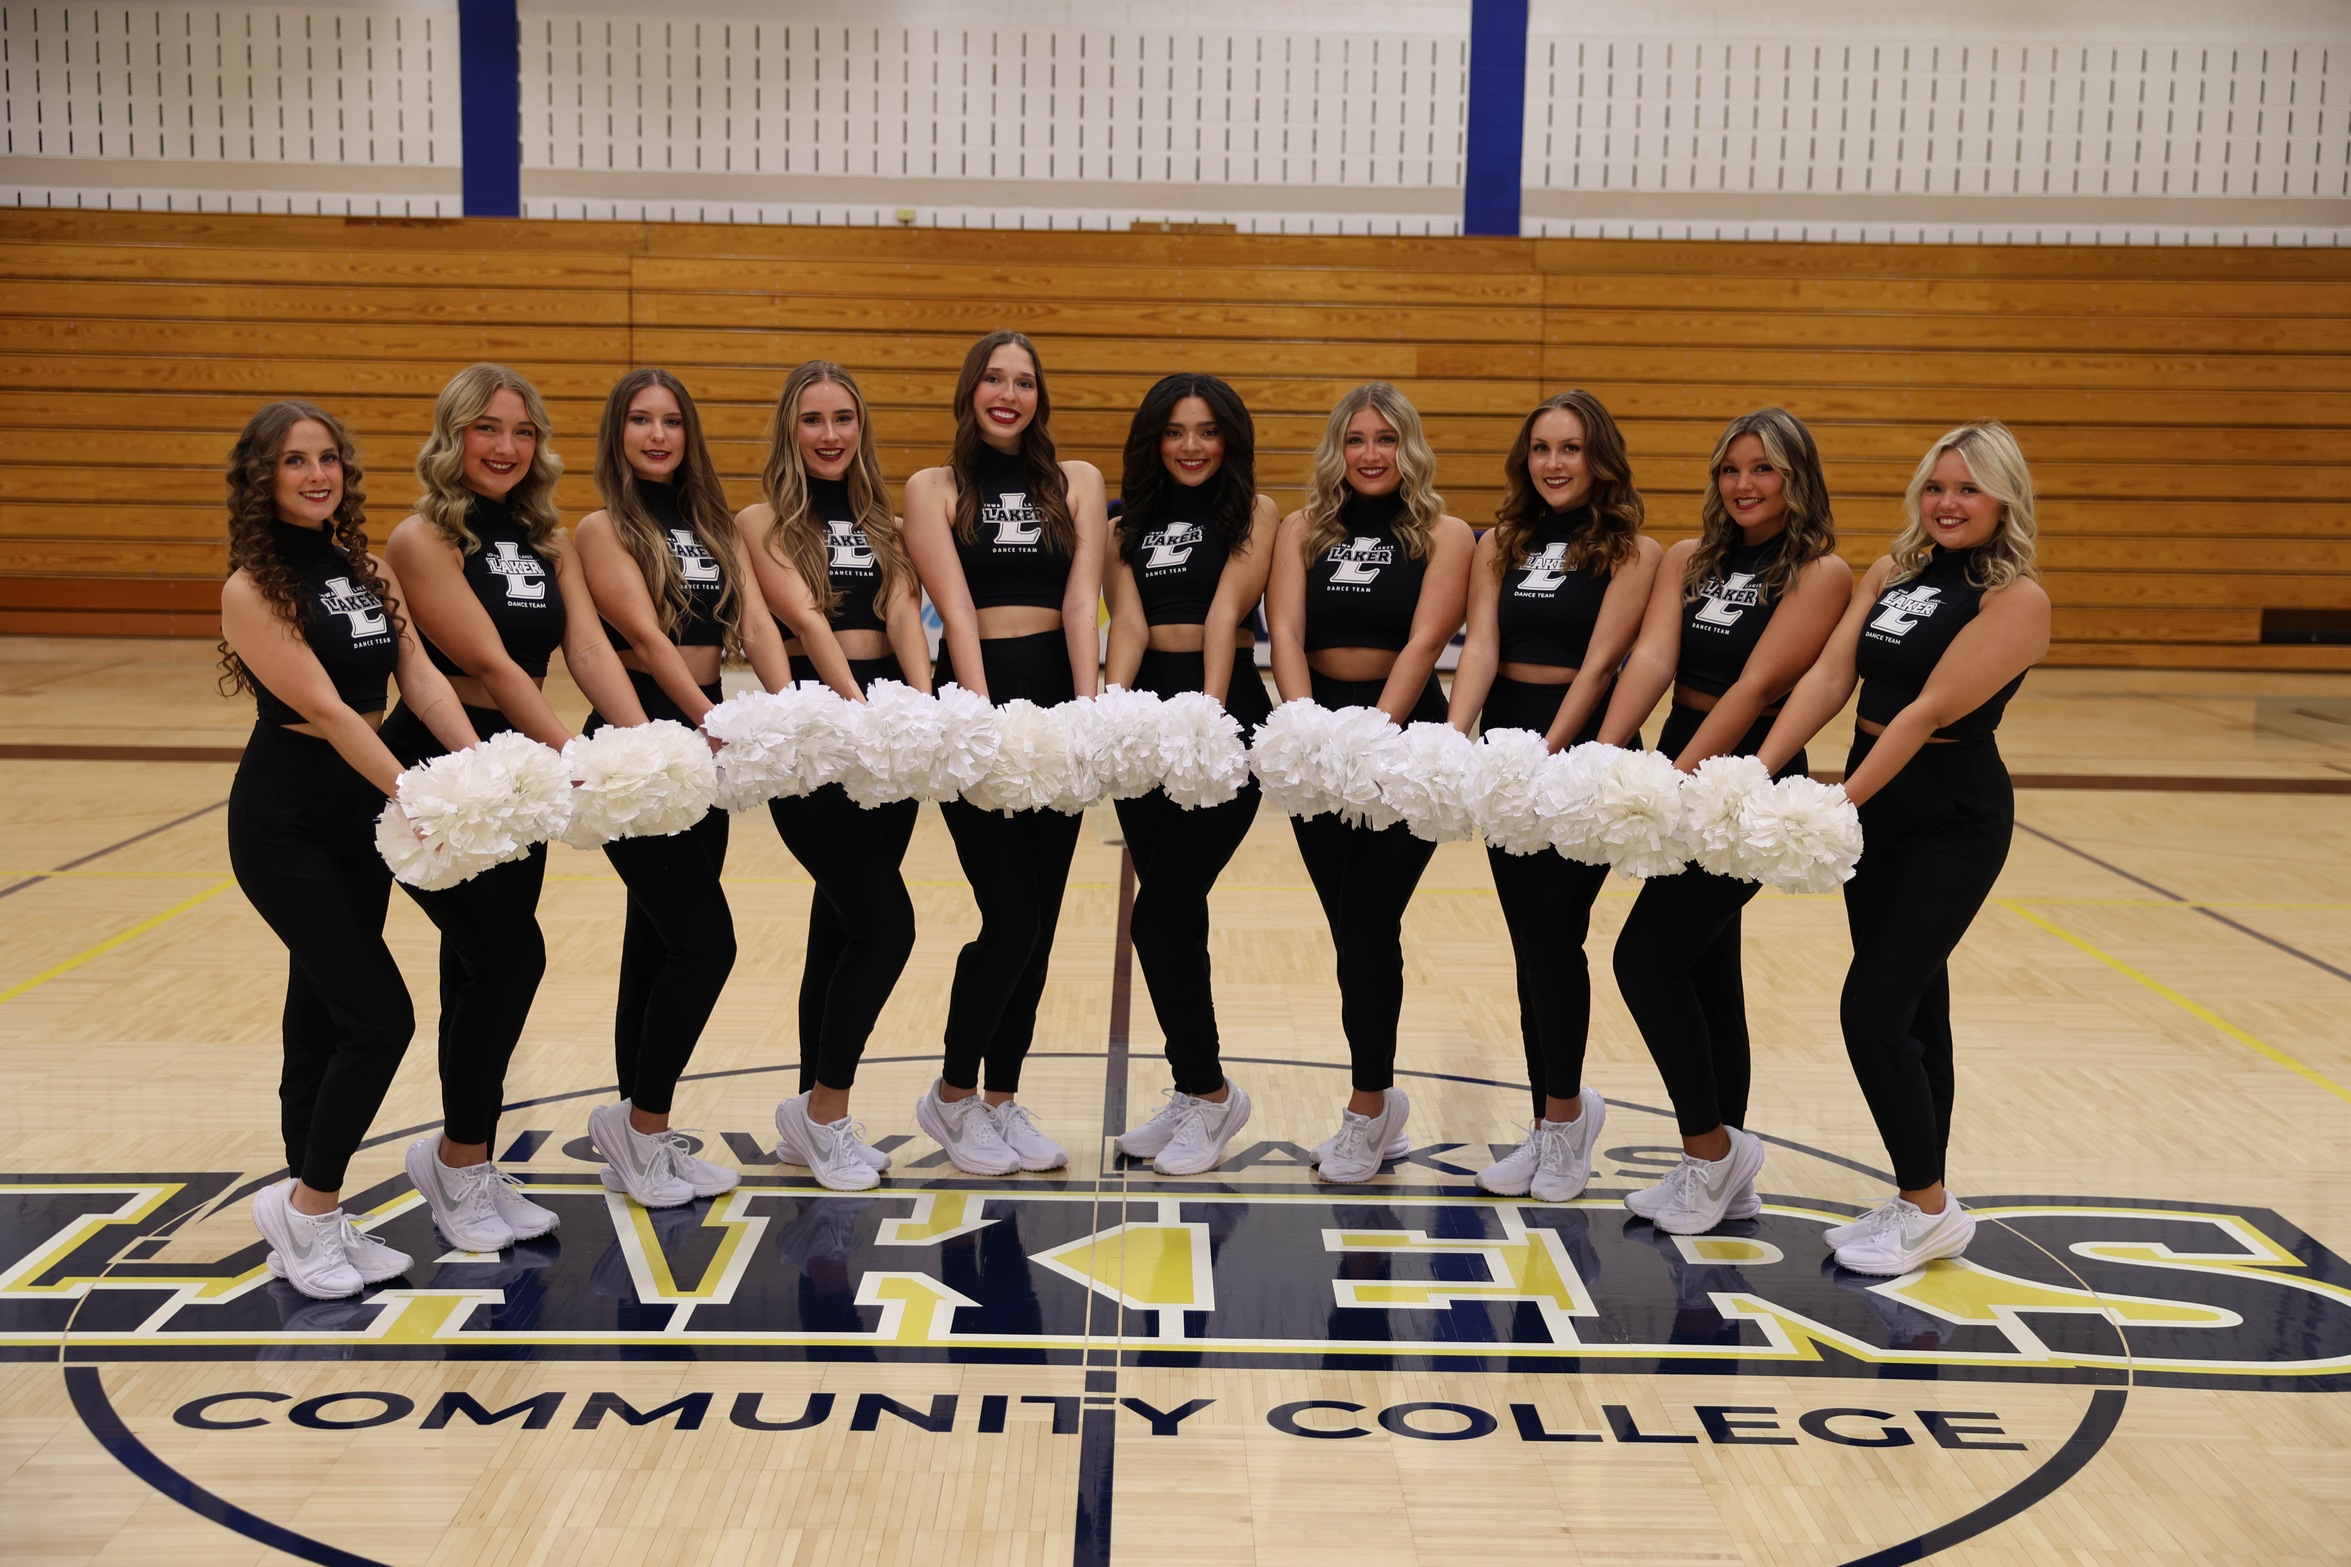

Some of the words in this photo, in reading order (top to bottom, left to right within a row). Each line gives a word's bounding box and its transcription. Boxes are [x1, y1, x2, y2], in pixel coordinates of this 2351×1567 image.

[1143, 530, 1202, 547] LAKER
[1330, 547, 1390, 562] LAKER
[488, 559, 543, 575] LAKER
[1145, 569, 1167, 578] DANCE
[1169, 566, 1187, 574] TEAM
[321, 592, 381, 613] LAKER
[507, 600, 528, 608] DANCE
[1882, 591, 1937, 615] LAKER
[1691, 622, 1712, 632] DANCE
[1713, 627, 1730, 635] TEAM
[353, 639, 374, 649] DANCE
[375, 637, 391, 646] TEAM
[1865, 631, 1885, 641] DANCE
[1884, 635, 1901, 645] TEAM
[172, 1390, 1217, 1437] COMMUNITY
[1266, 1399, 2029, 1452] COLLEGE
